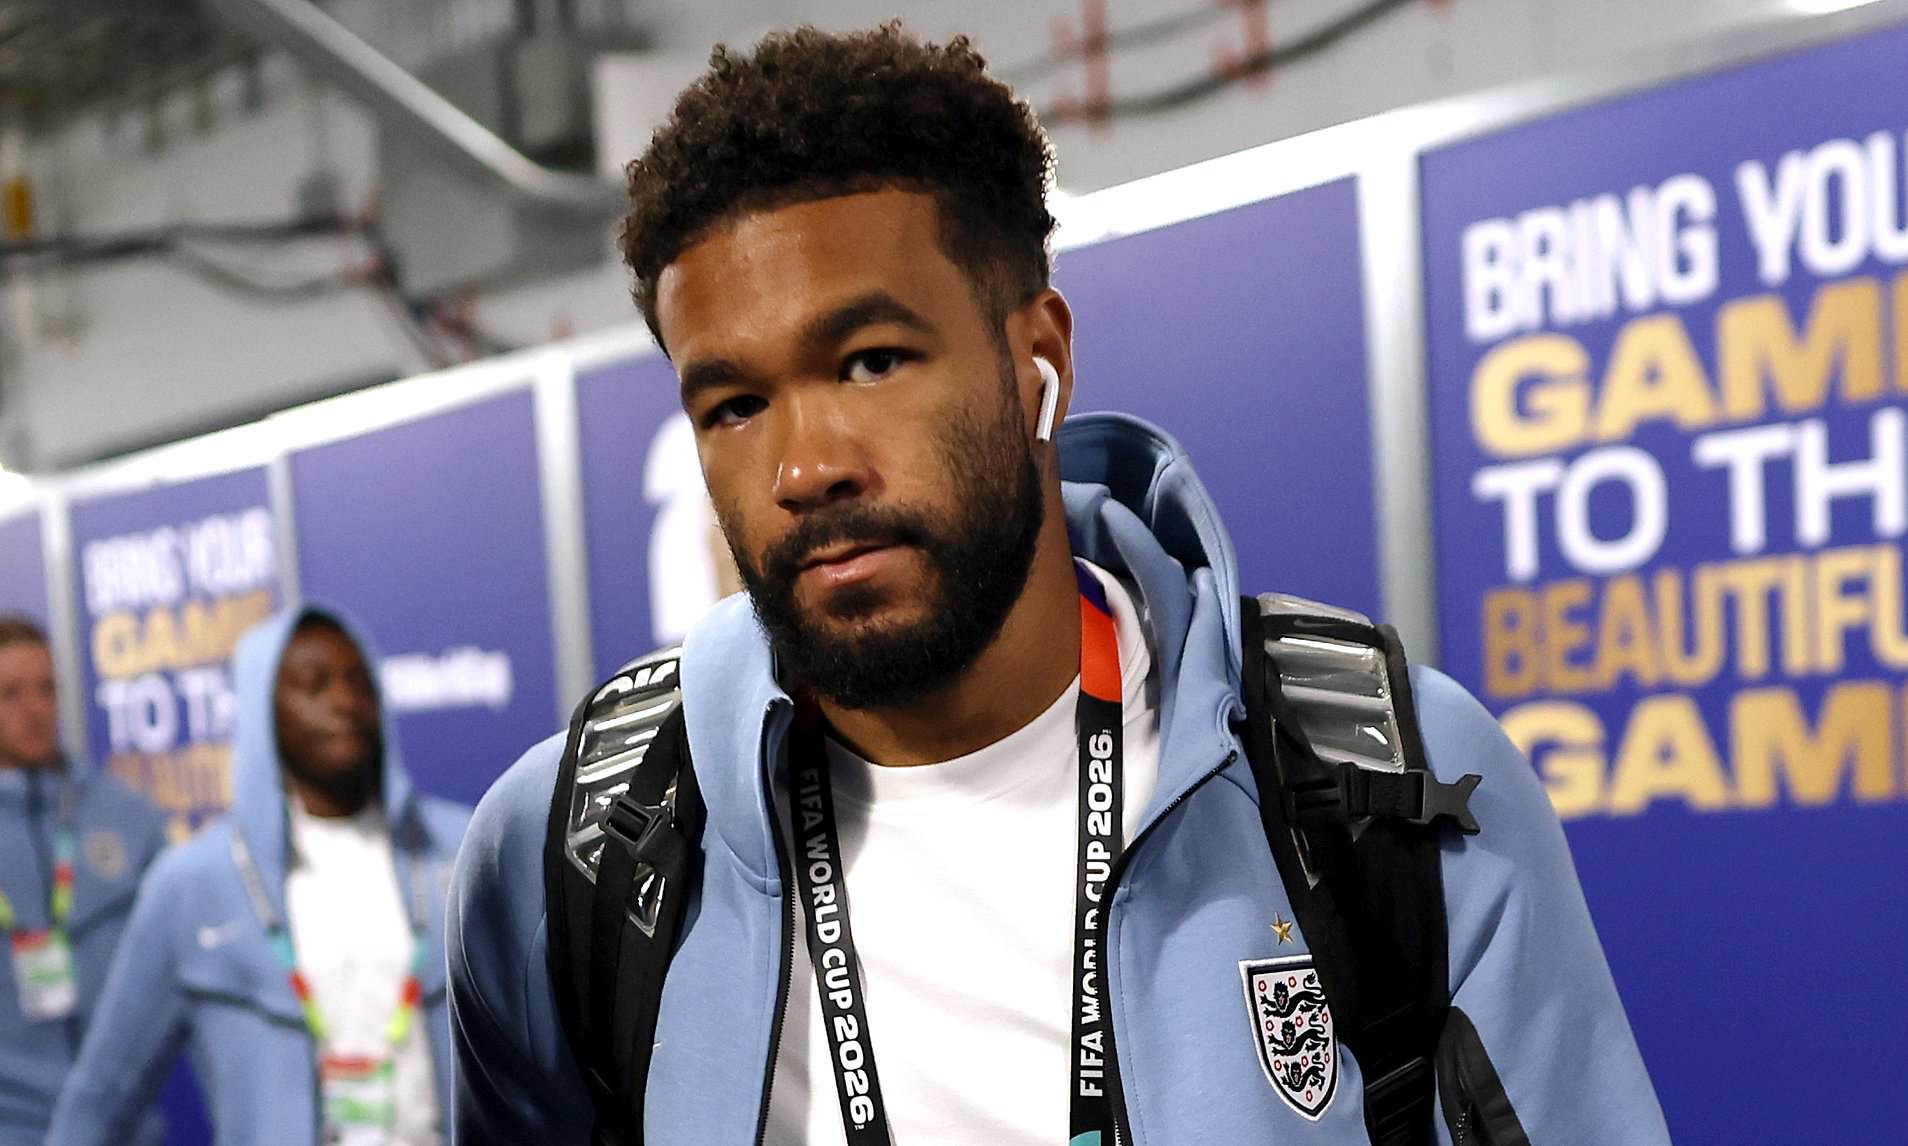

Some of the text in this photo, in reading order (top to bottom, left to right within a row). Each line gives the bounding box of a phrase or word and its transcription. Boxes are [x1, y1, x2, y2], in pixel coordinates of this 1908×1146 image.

[1462, 130, 1908, 342] BRING YOU
[1470, 270, 1908, 459] GAM
[1472, 407, 1907, 582] TO TH
[95, 671, 179, 754] TO
[1499, 679, 1908, 822] GAM
[800, 768, 824, 831] FIFA
[806, 832, 841, 944] WORLD
[1084, 840, 1111, 903] CUP
[822, 948, 853, 1010] CUP
[1080, 1031, 1103, 1097] FIFA
